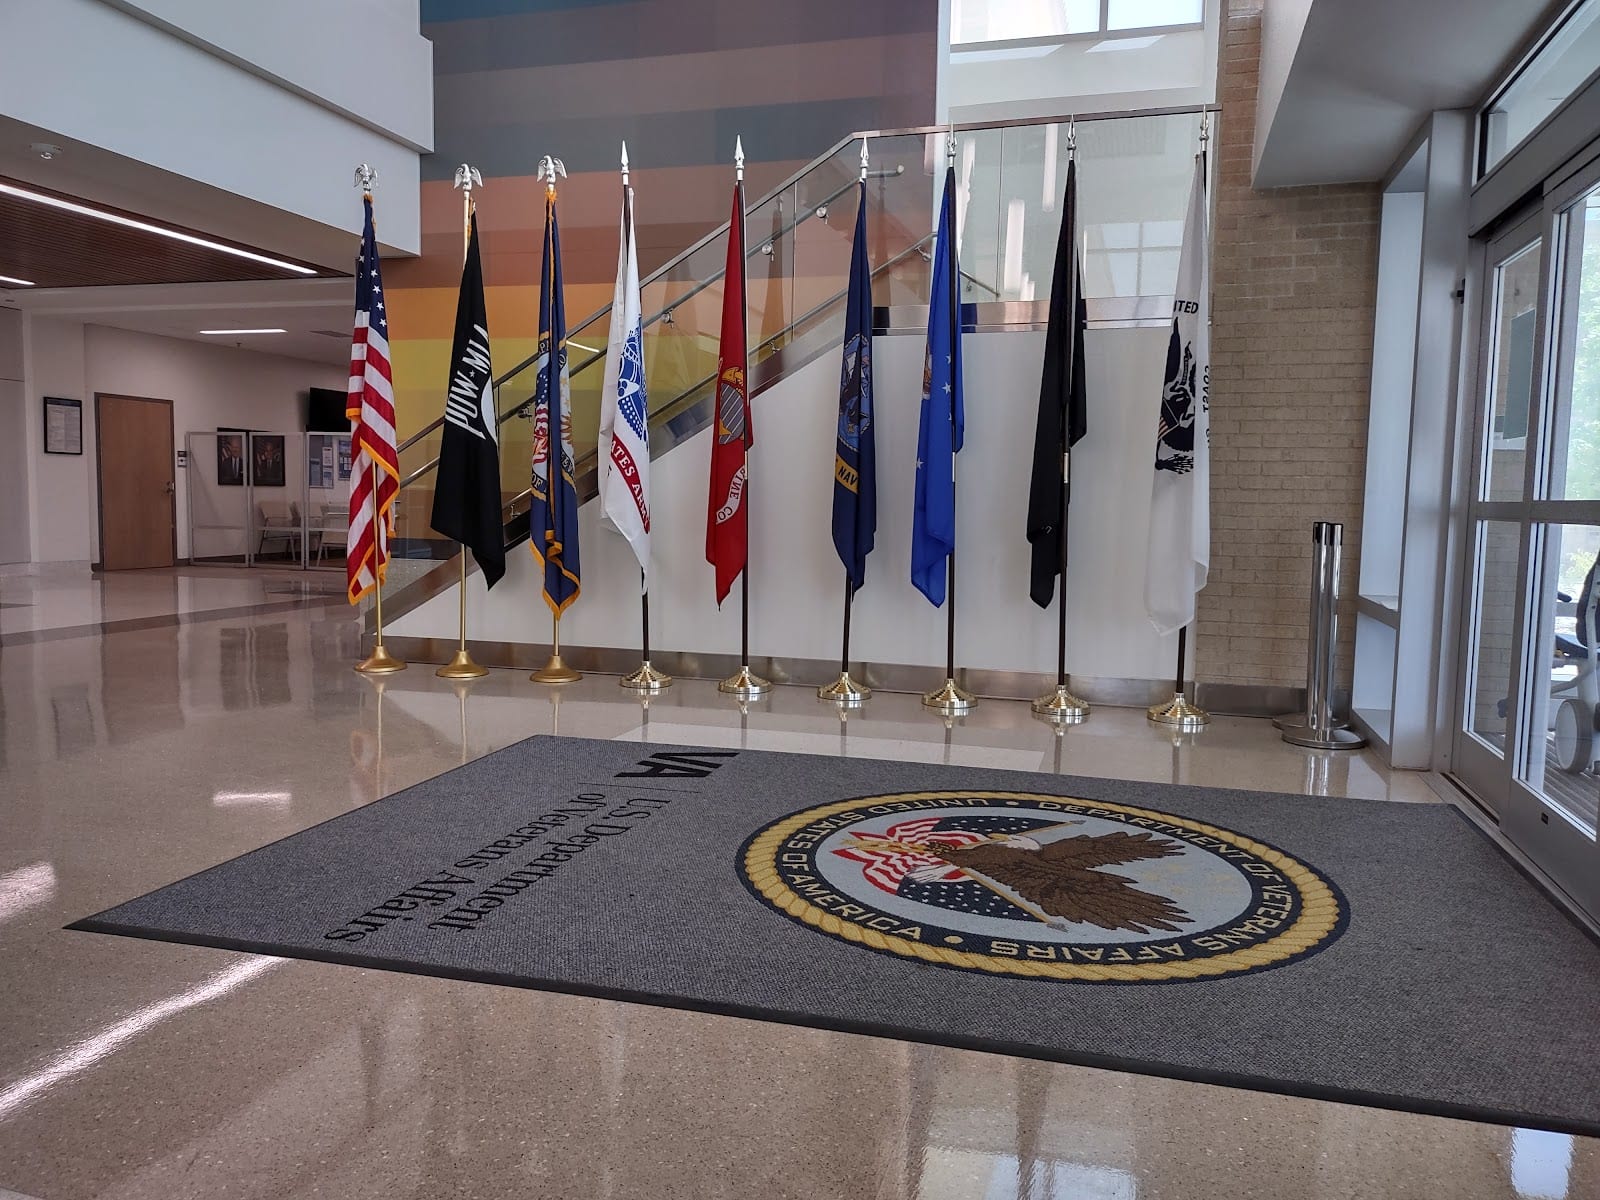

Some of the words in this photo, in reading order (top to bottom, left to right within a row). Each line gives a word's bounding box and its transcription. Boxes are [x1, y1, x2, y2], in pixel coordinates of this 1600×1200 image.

[614, 752, 740, 778] VA
[568, 792, 607, 808] of
[602, 798, 672, 819] U.S.
[867, 798, 990, 815] UNITED
[454, 806, 588, 870] Veterans
[786, 811, 866, 851] STATES
[1038, 801, 1254, 860] DEPARTMENT
[428, 823, 633, 932] Department
[781, 852, 811, 873] OF
[1240, 862, 1284, 883] OF
[324, 869, 475, 942] Affairs
[788, 874, 922, 940] AMERICA
[1191, 882, 1293, 951] VETERANS
[990, 940, 1186, 962] AFFAIRS
